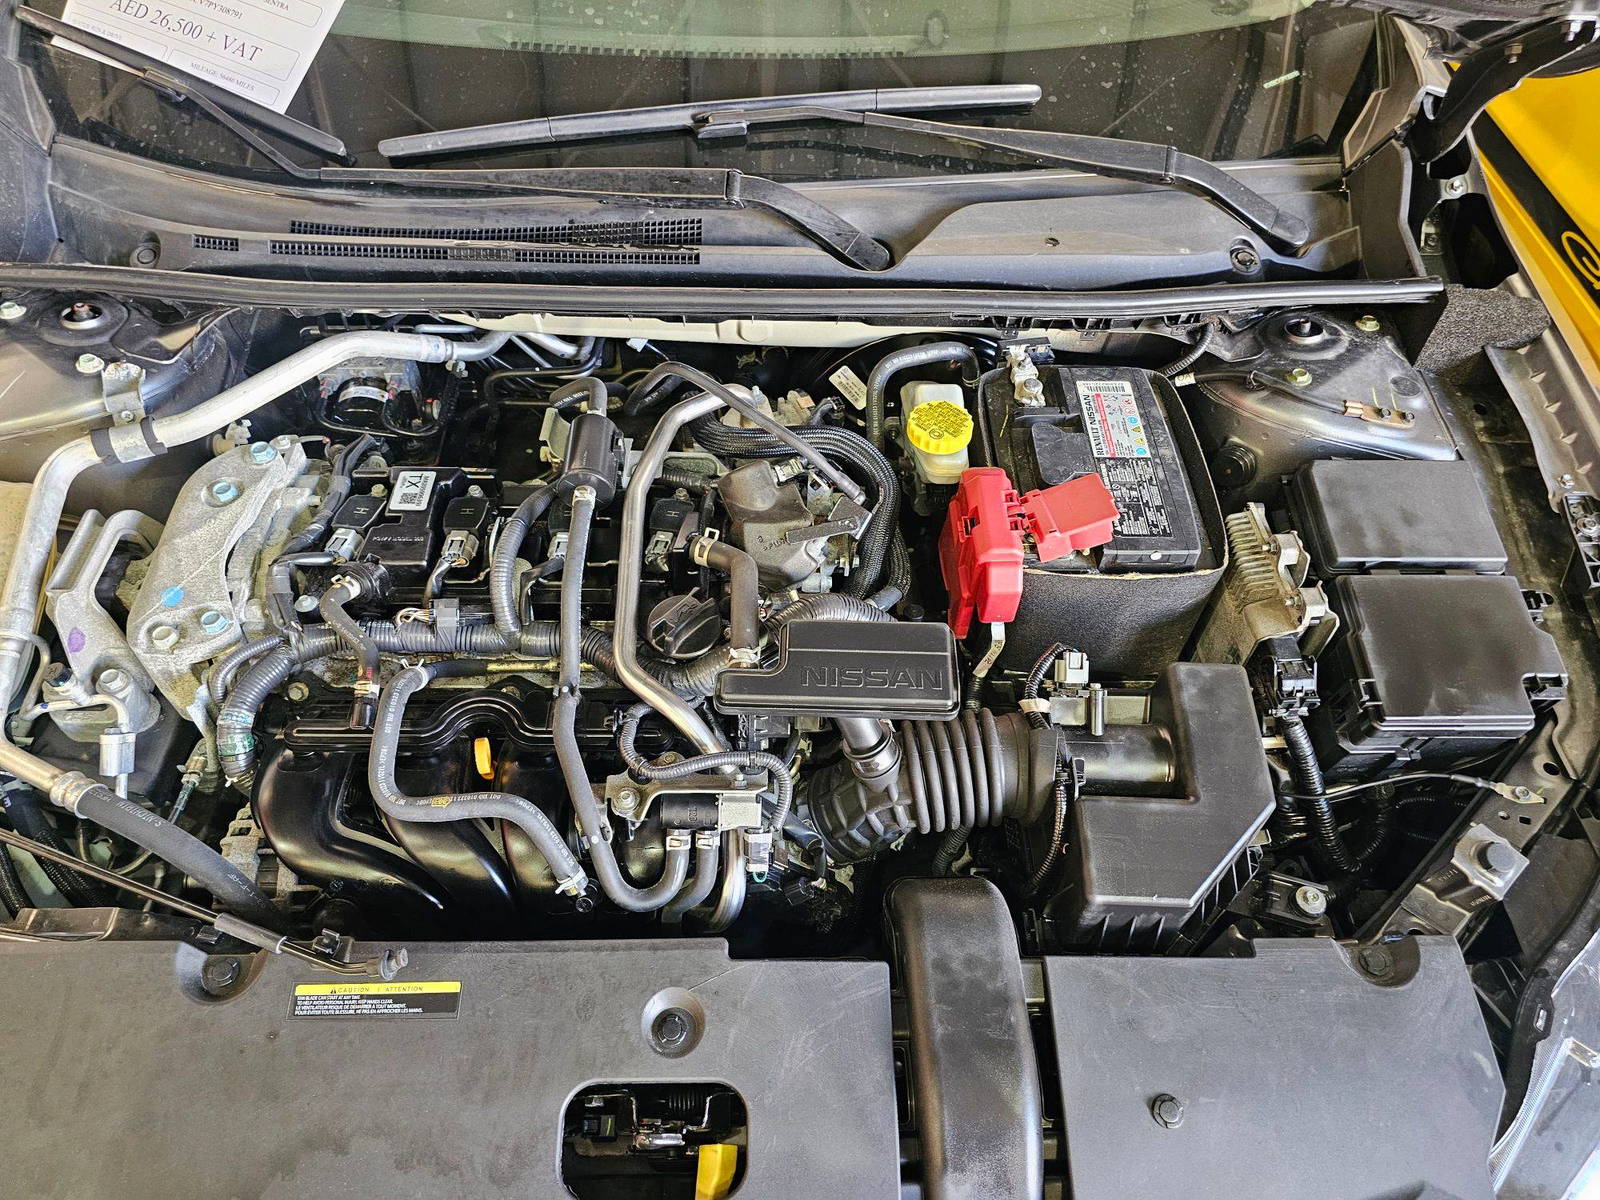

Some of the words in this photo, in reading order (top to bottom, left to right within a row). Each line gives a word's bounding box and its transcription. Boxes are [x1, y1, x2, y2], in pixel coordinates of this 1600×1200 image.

[109, 0, 148, 20] AED
[150, 9, 203, 41] 26,500
[206, 30, 217, 43] +
[223, 34, 263, 63] VAT
[1083, 394, 1096, 425] NISSAN
[801, 666, 942, 691] NISSAN
